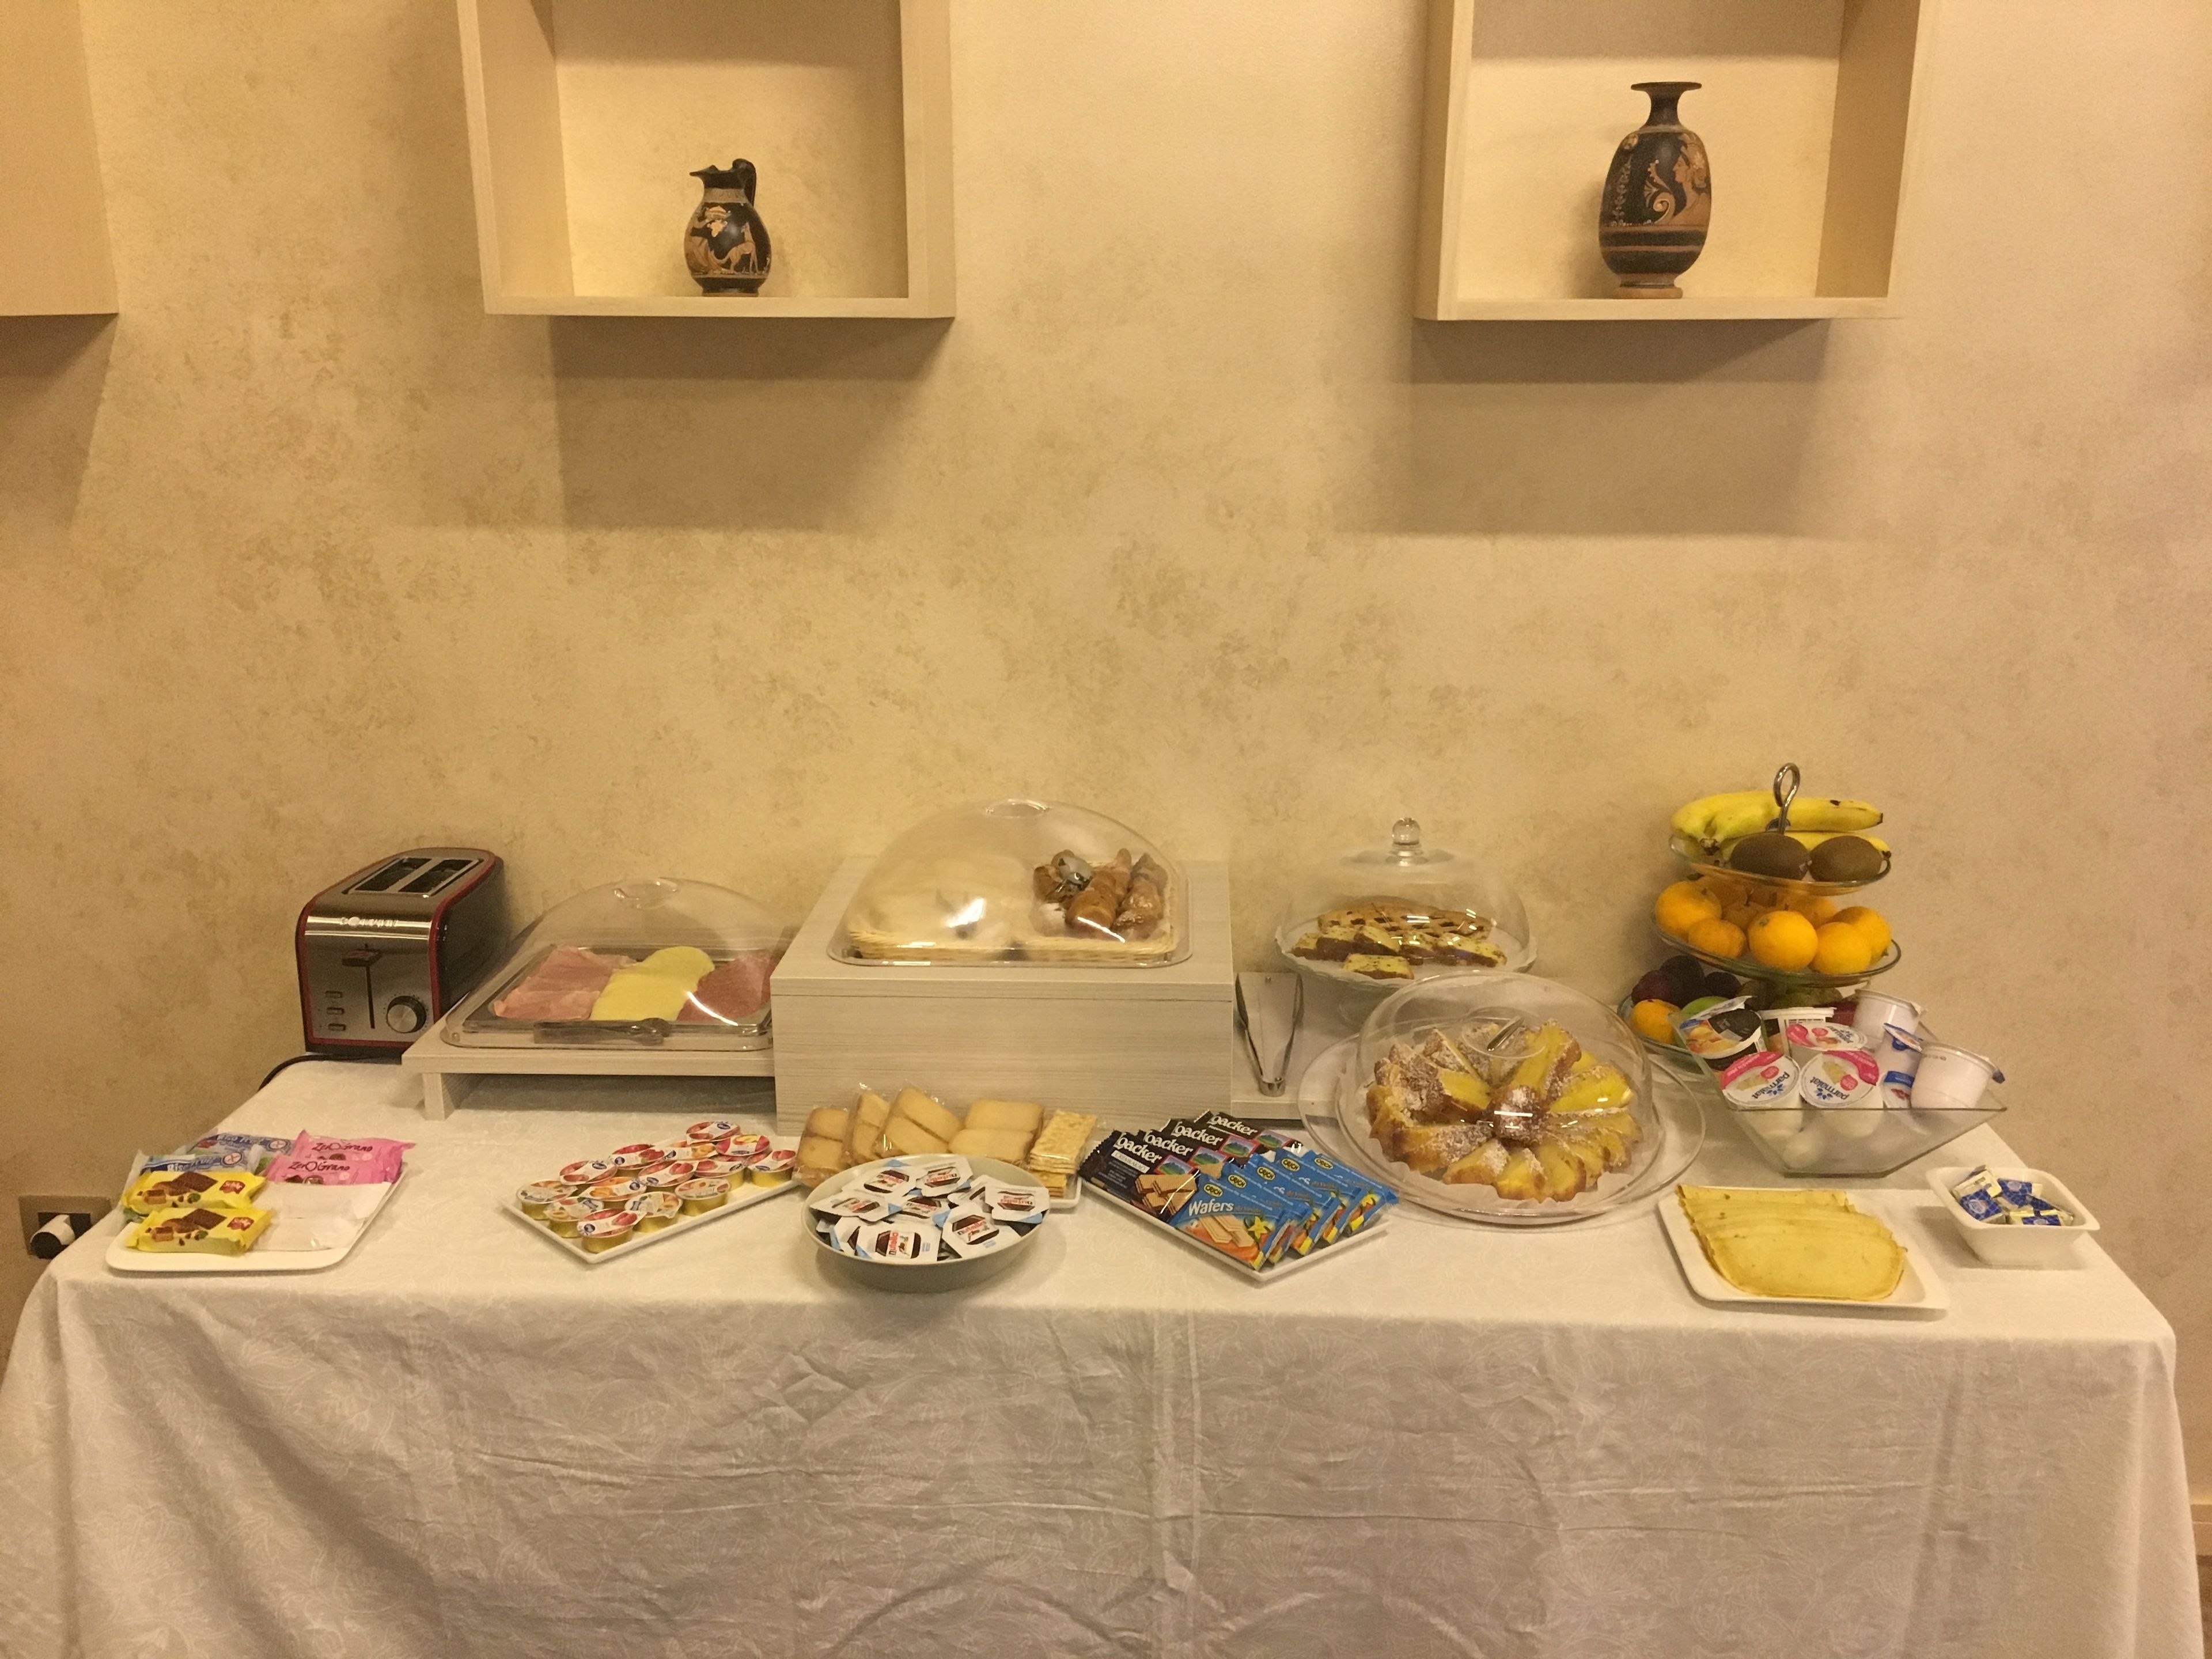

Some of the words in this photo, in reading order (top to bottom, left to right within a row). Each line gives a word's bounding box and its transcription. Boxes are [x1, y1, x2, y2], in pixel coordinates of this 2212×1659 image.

[1752, 1071, 1790, 1100] parmalat
[1810, 1077, 1850, 1100] parmalat
[1188, 1199, 1234, 1216] Wafers
[888, 1232, 899, 1255] nutella
